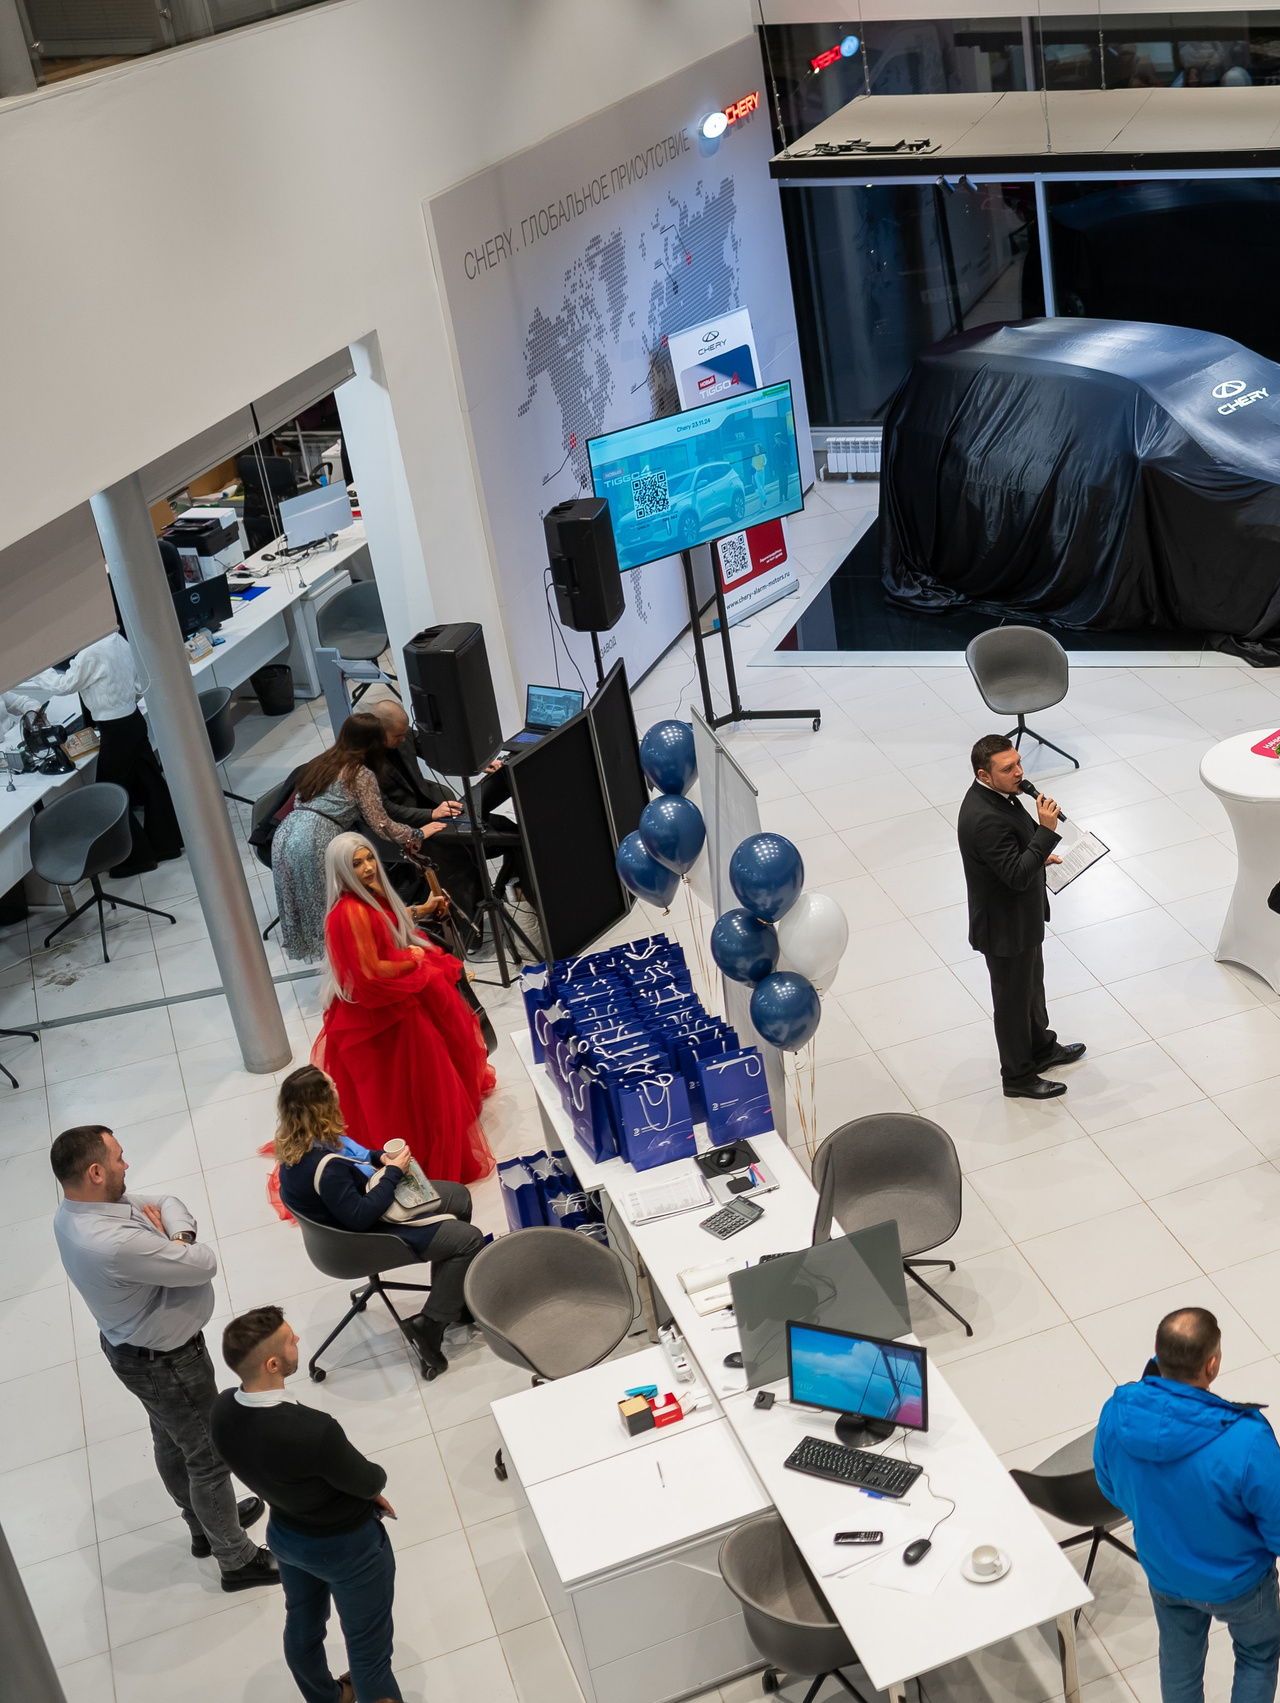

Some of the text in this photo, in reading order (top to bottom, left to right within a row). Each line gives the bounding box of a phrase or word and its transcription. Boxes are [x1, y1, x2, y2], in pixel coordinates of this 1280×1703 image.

[724, 91, 759, 125] CHERY
[463, 127, 690, 280] CHERY. ГЛОБАЛЬНОЕ ПРИСУТСТВИЕ
[697, 339, 727, 356] CHERY
[1217, 387, 1269, 416] CHERY
[676, 418, 711, 433] Chery 23.11.24
[726, 571, 790, 610] www.chery-alarm-motors.ru
